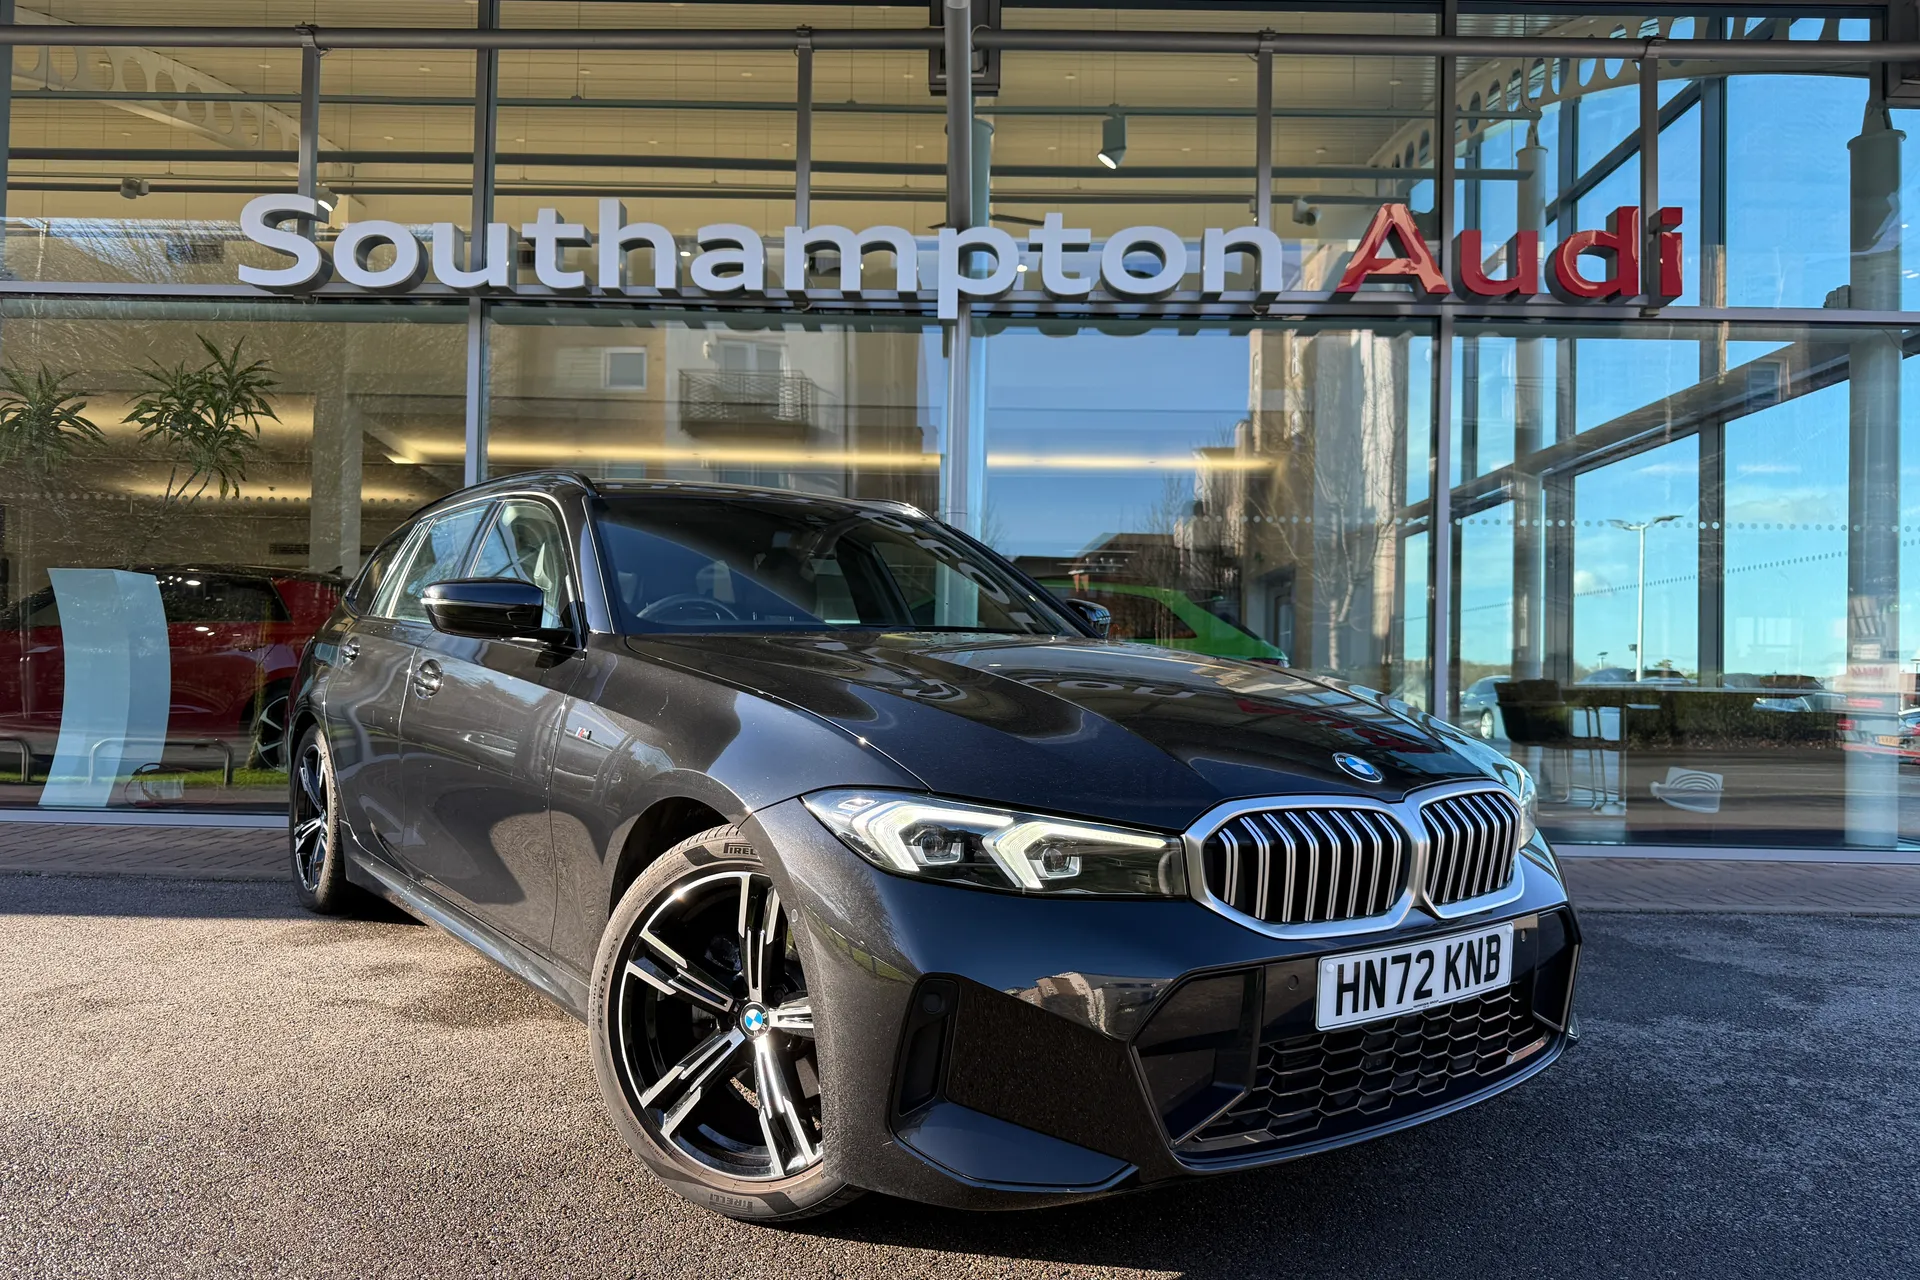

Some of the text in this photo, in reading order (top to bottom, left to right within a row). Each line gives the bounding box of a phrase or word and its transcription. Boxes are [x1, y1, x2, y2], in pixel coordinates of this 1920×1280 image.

[237, 193, 1683, 320] Southampton Audi
[723, 842, 758, 856] PIREL
[1335, 933, 1501, 1017] HN72 KNB
[708, 1193, 755, 1213] PIRELLI
